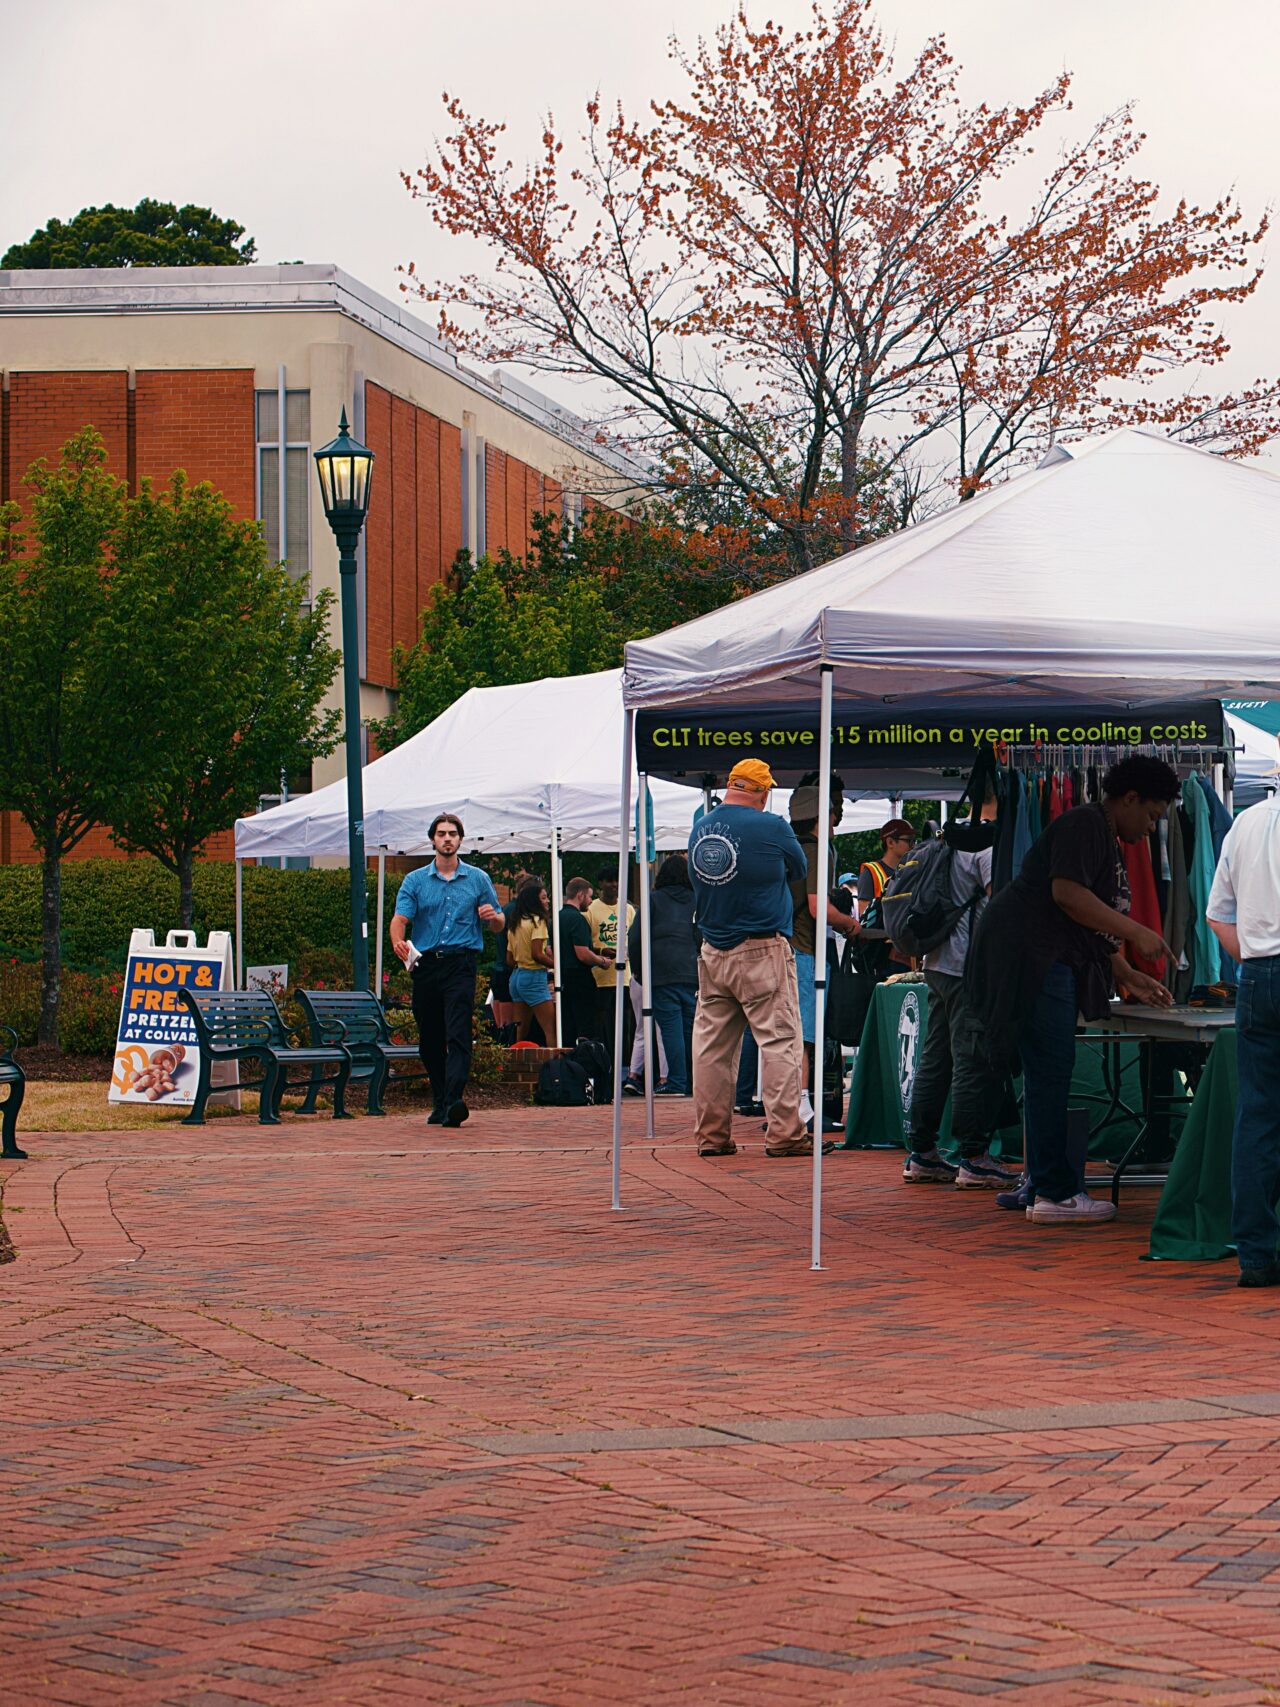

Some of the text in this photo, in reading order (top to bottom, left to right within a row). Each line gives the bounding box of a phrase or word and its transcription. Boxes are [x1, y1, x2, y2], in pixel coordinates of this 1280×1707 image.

[1226, 700, 1269, 709] SAFETY
[652, 720, 1207, 747] CLT trees save 15 million a year in cooling costs
[133, 962, 213, 987] HOT &
[127, 1013, 203, 1029] PRETZEL
[124, 1028, 199, 1042] AT COLVAR
